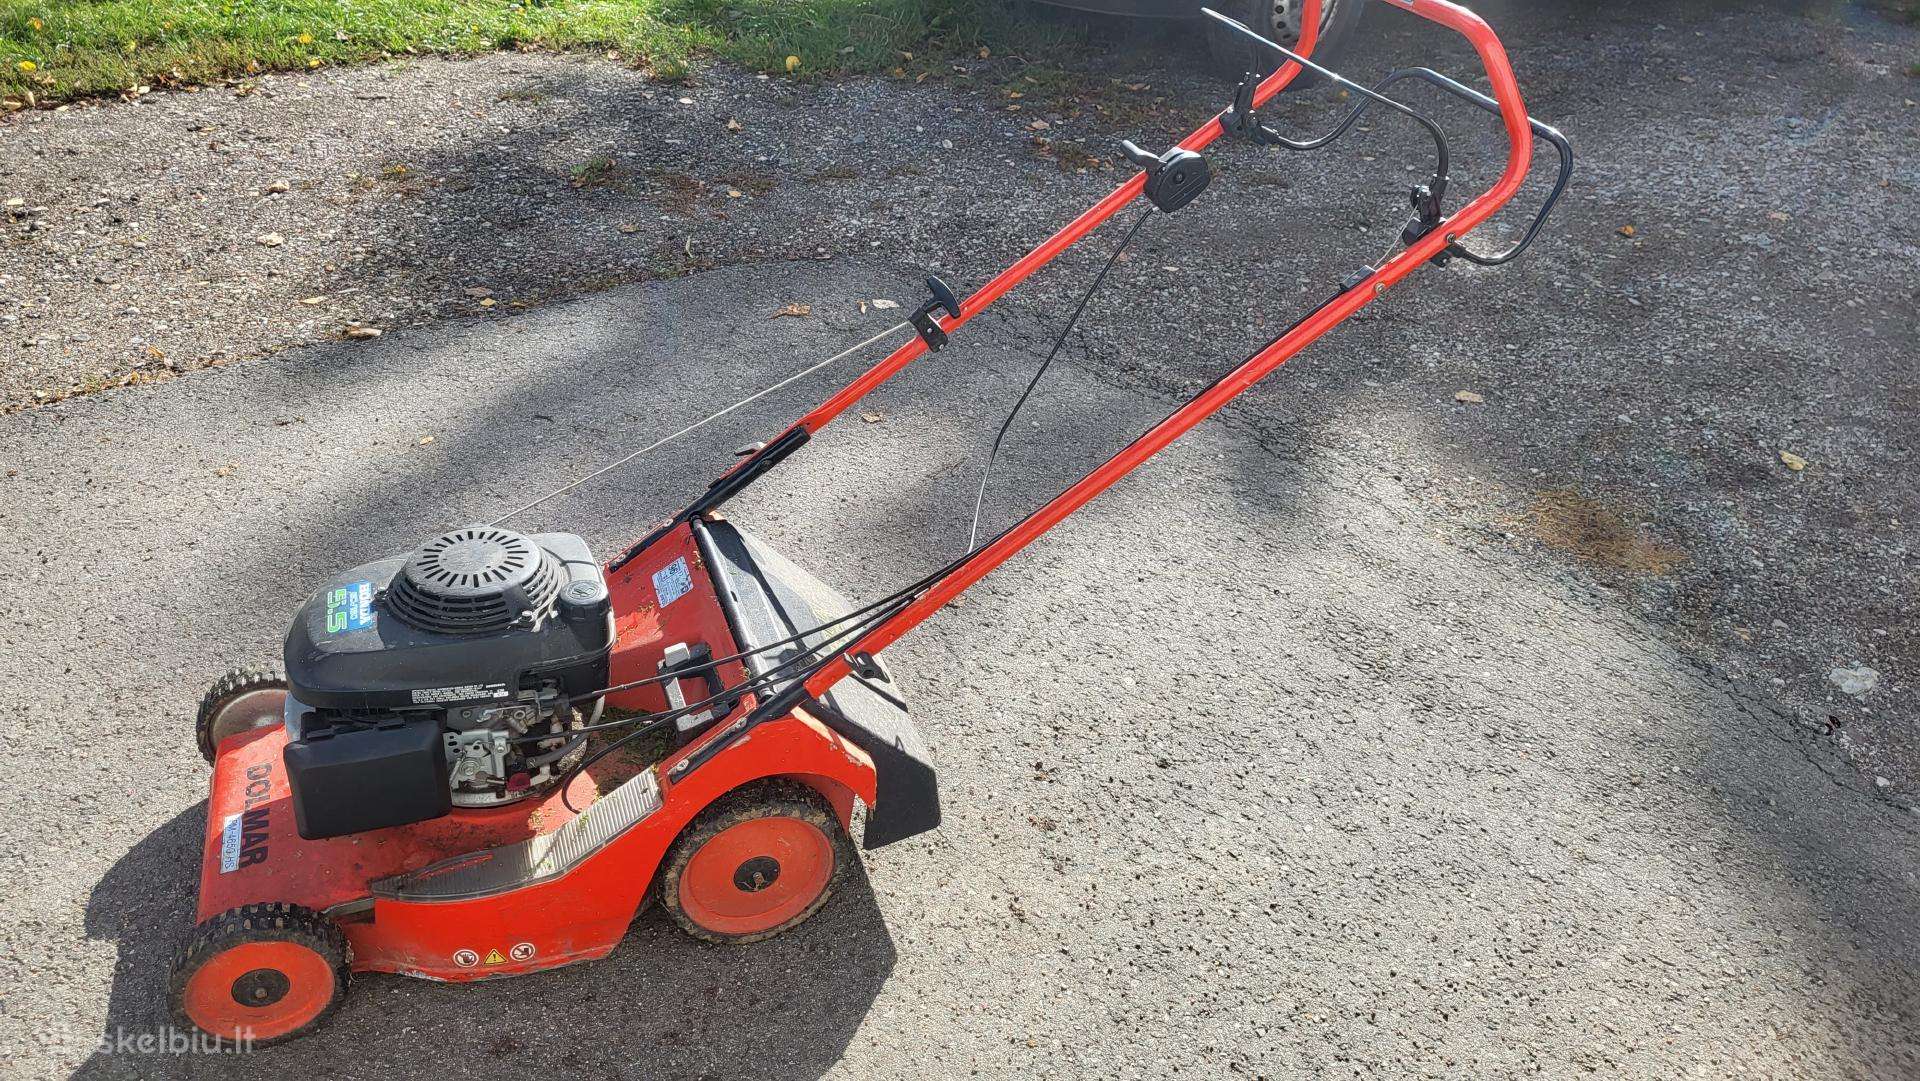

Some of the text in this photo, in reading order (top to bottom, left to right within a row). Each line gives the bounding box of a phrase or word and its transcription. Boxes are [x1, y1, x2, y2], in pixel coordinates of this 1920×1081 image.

[327, 589, 347, 632] 5.5
[239, 763, 272, 869] DOLMAR
[225, 856, 235, 869] HS
